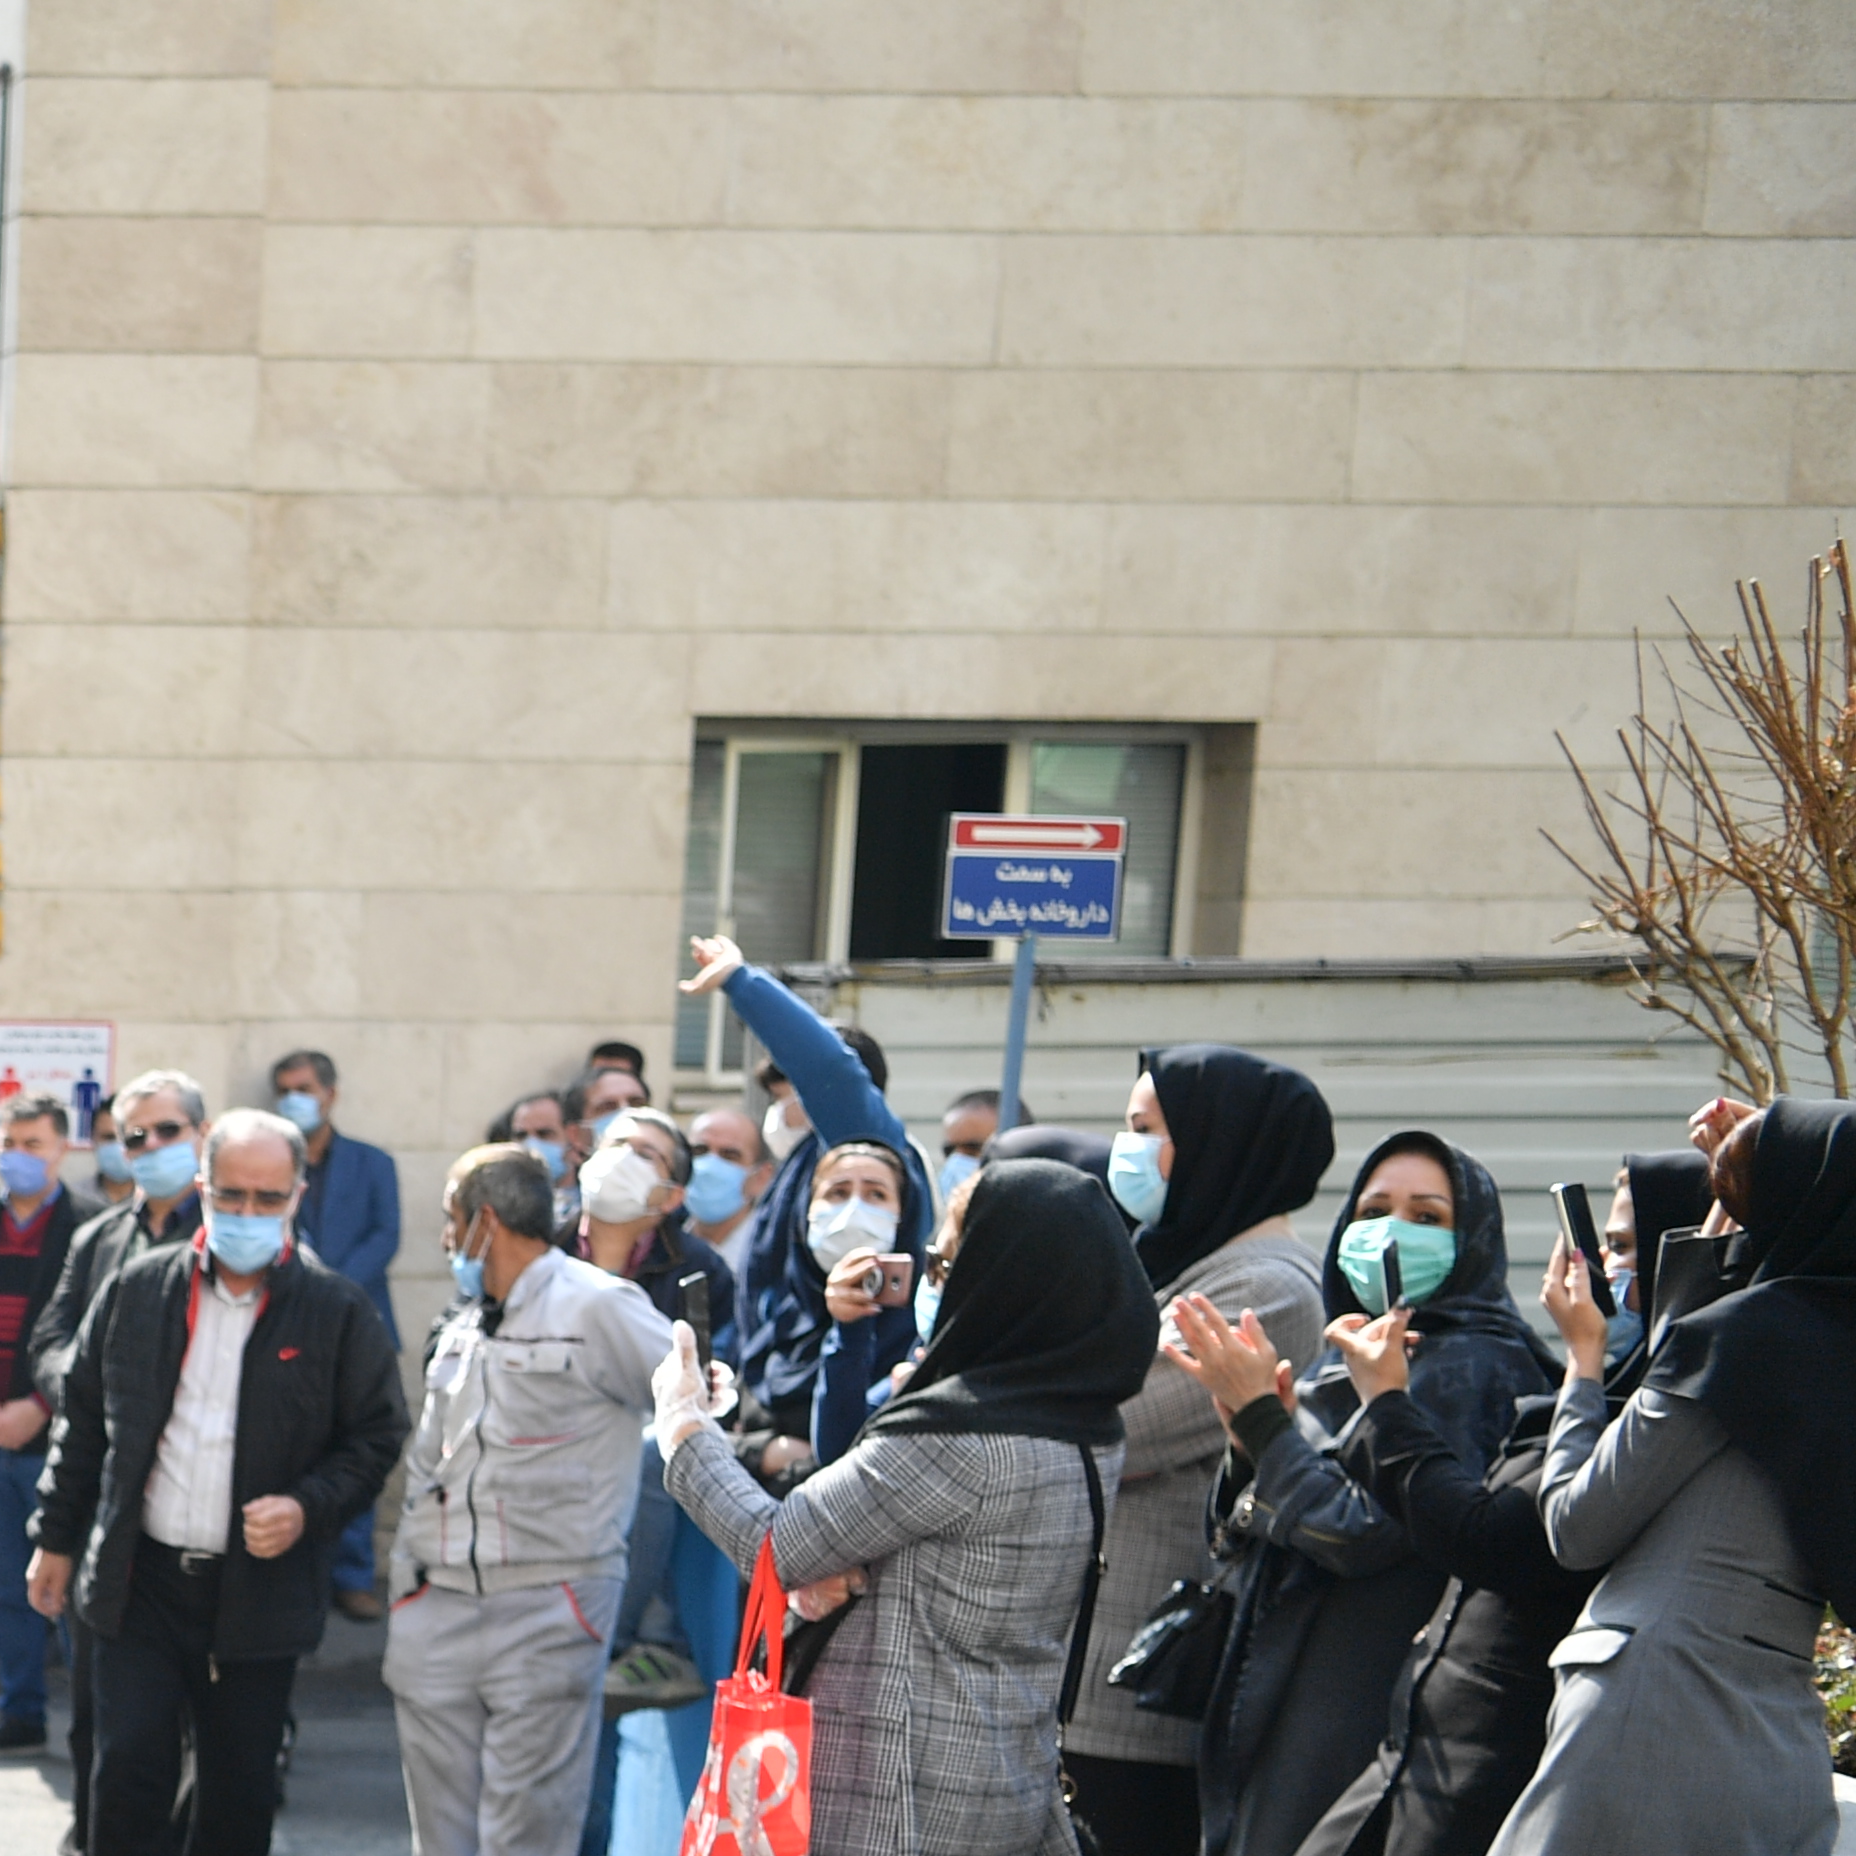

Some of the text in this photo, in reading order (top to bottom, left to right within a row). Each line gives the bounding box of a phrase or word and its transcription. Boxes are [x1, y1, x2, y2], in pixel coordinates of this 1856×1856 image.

[995, 861, 1074, 889] به سمت
[952, 896, 1110, 929] داروخانه بخش ها
